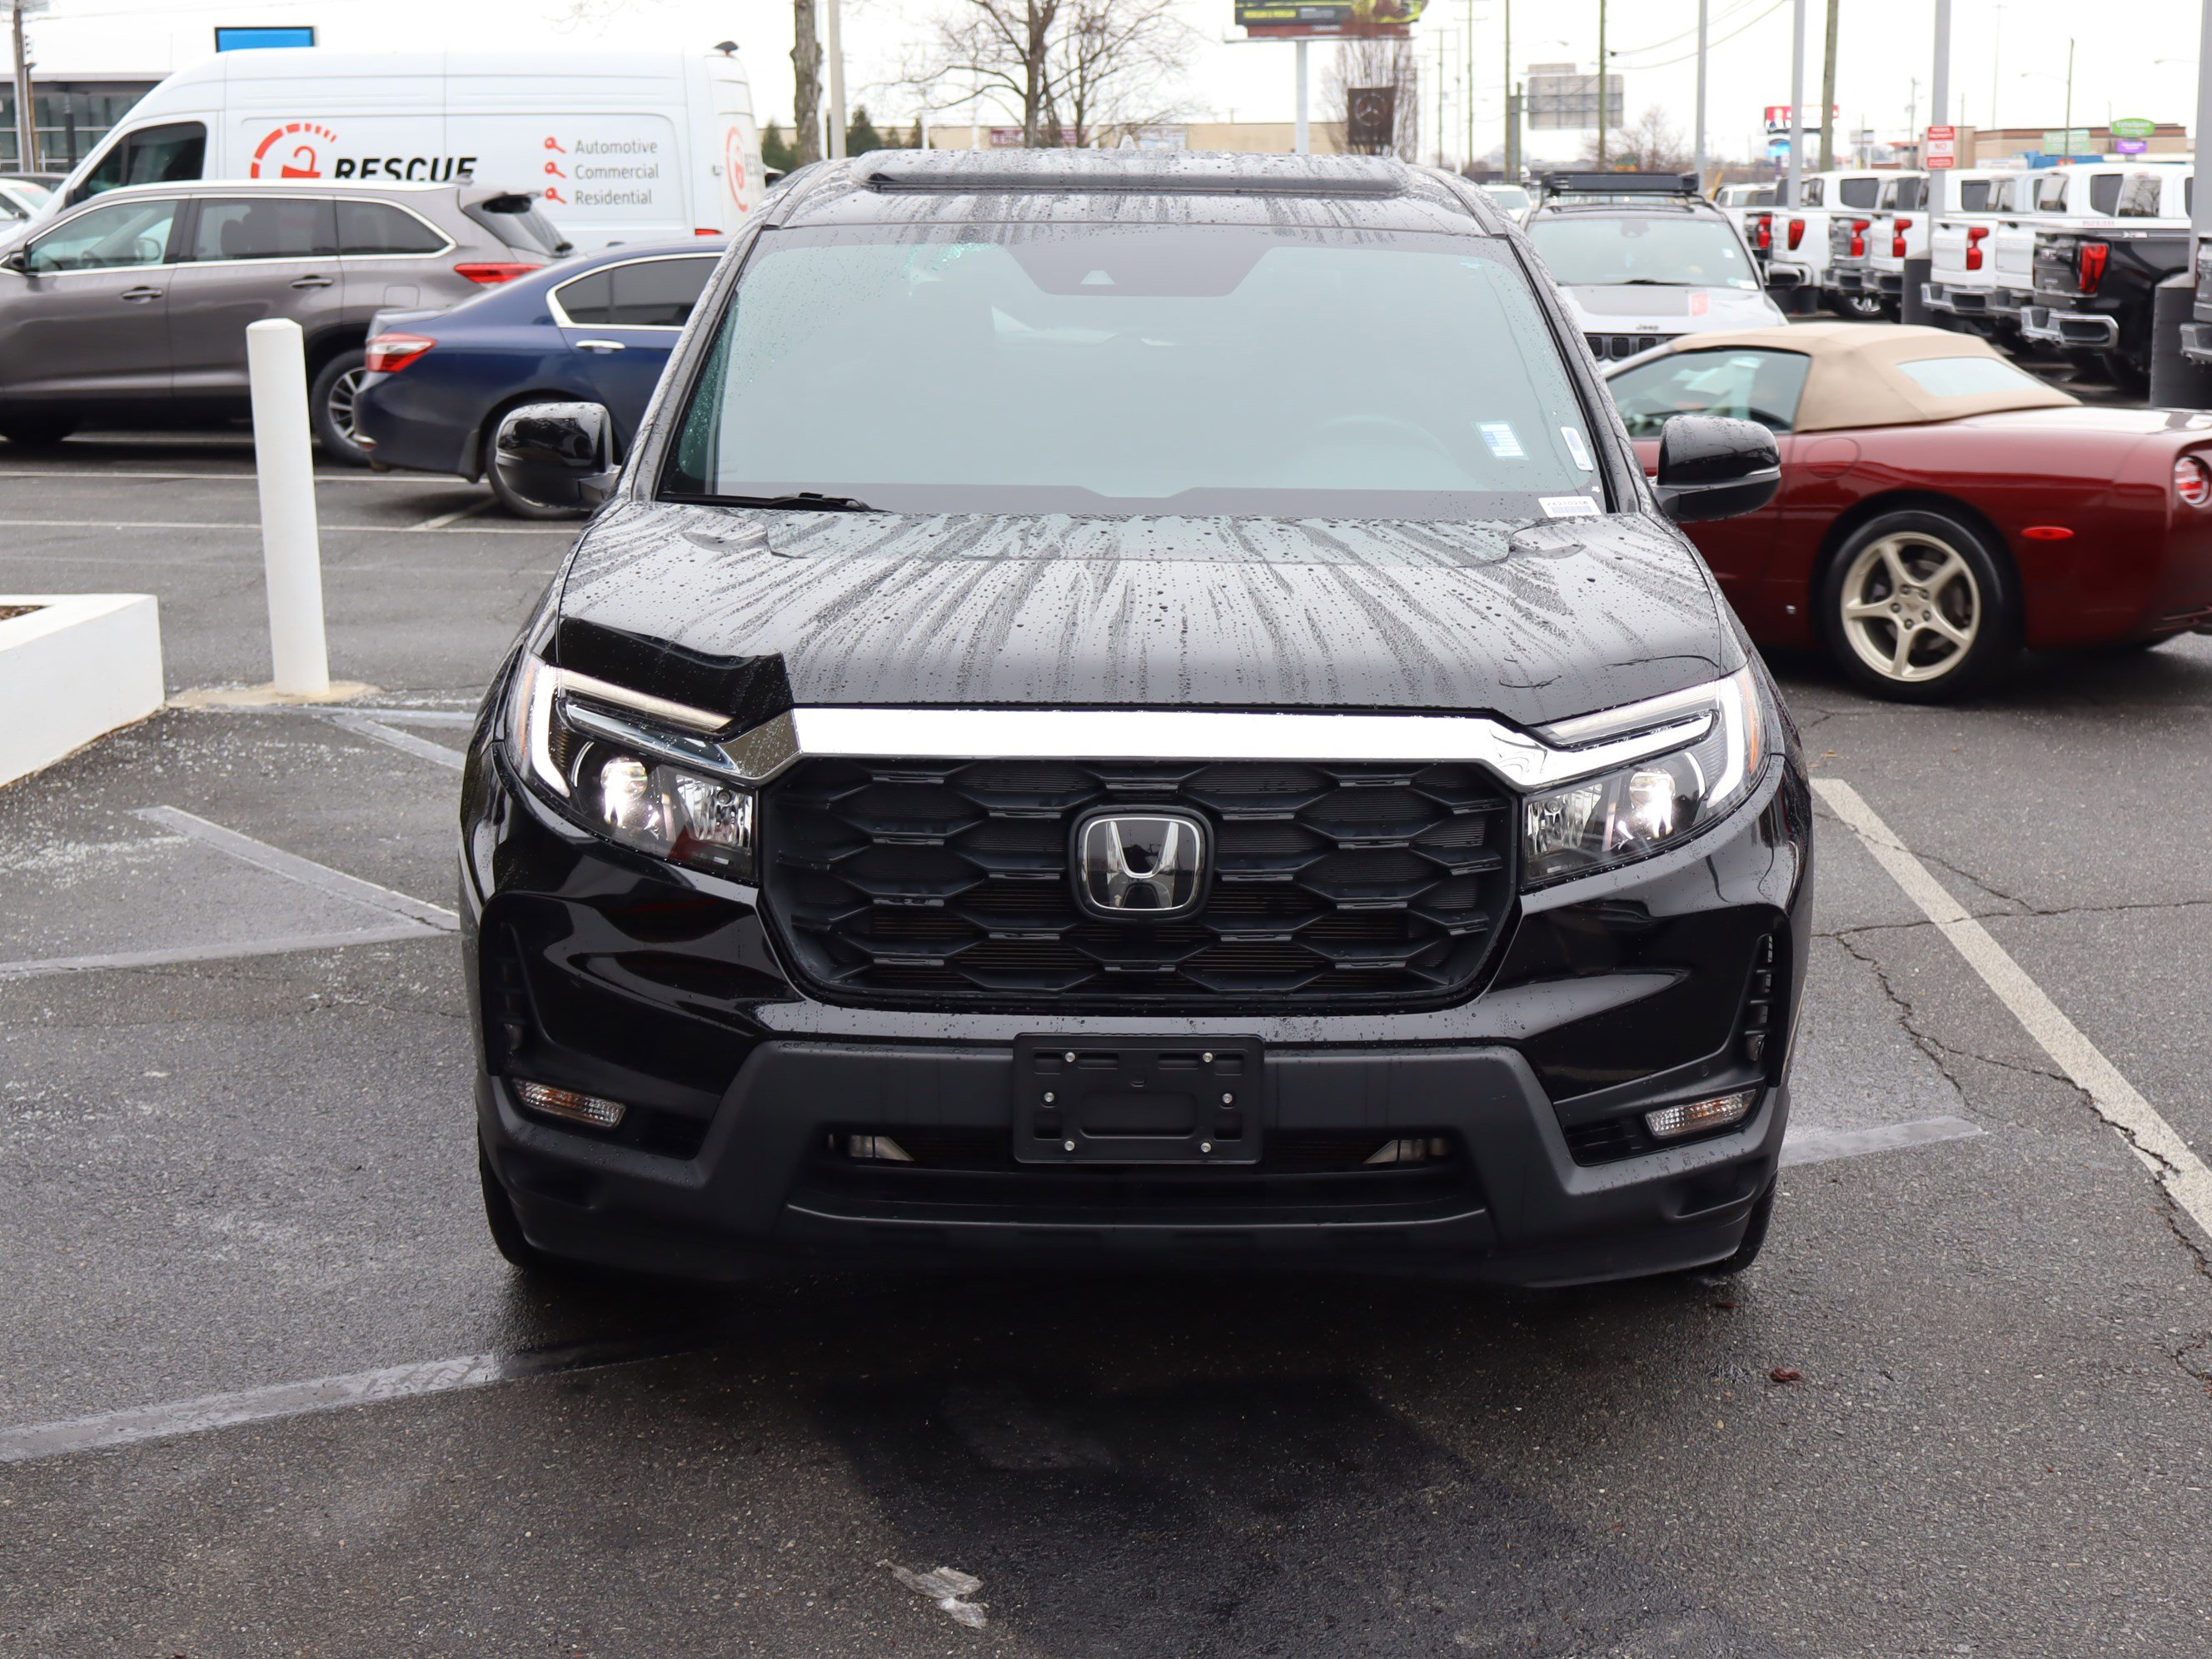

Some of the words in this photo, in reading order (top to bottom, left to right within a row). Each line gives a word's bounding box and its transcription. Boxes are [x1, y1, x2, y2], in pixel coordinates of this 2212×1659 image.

[575, 140, 658, 154] Automotive
[335, 157, 477, 181] RESCUE
[575, 163, 659, 179] Commercial
[575, 189, 652, 205] Residential
[1636, 323, 1660, 333] Jeep
